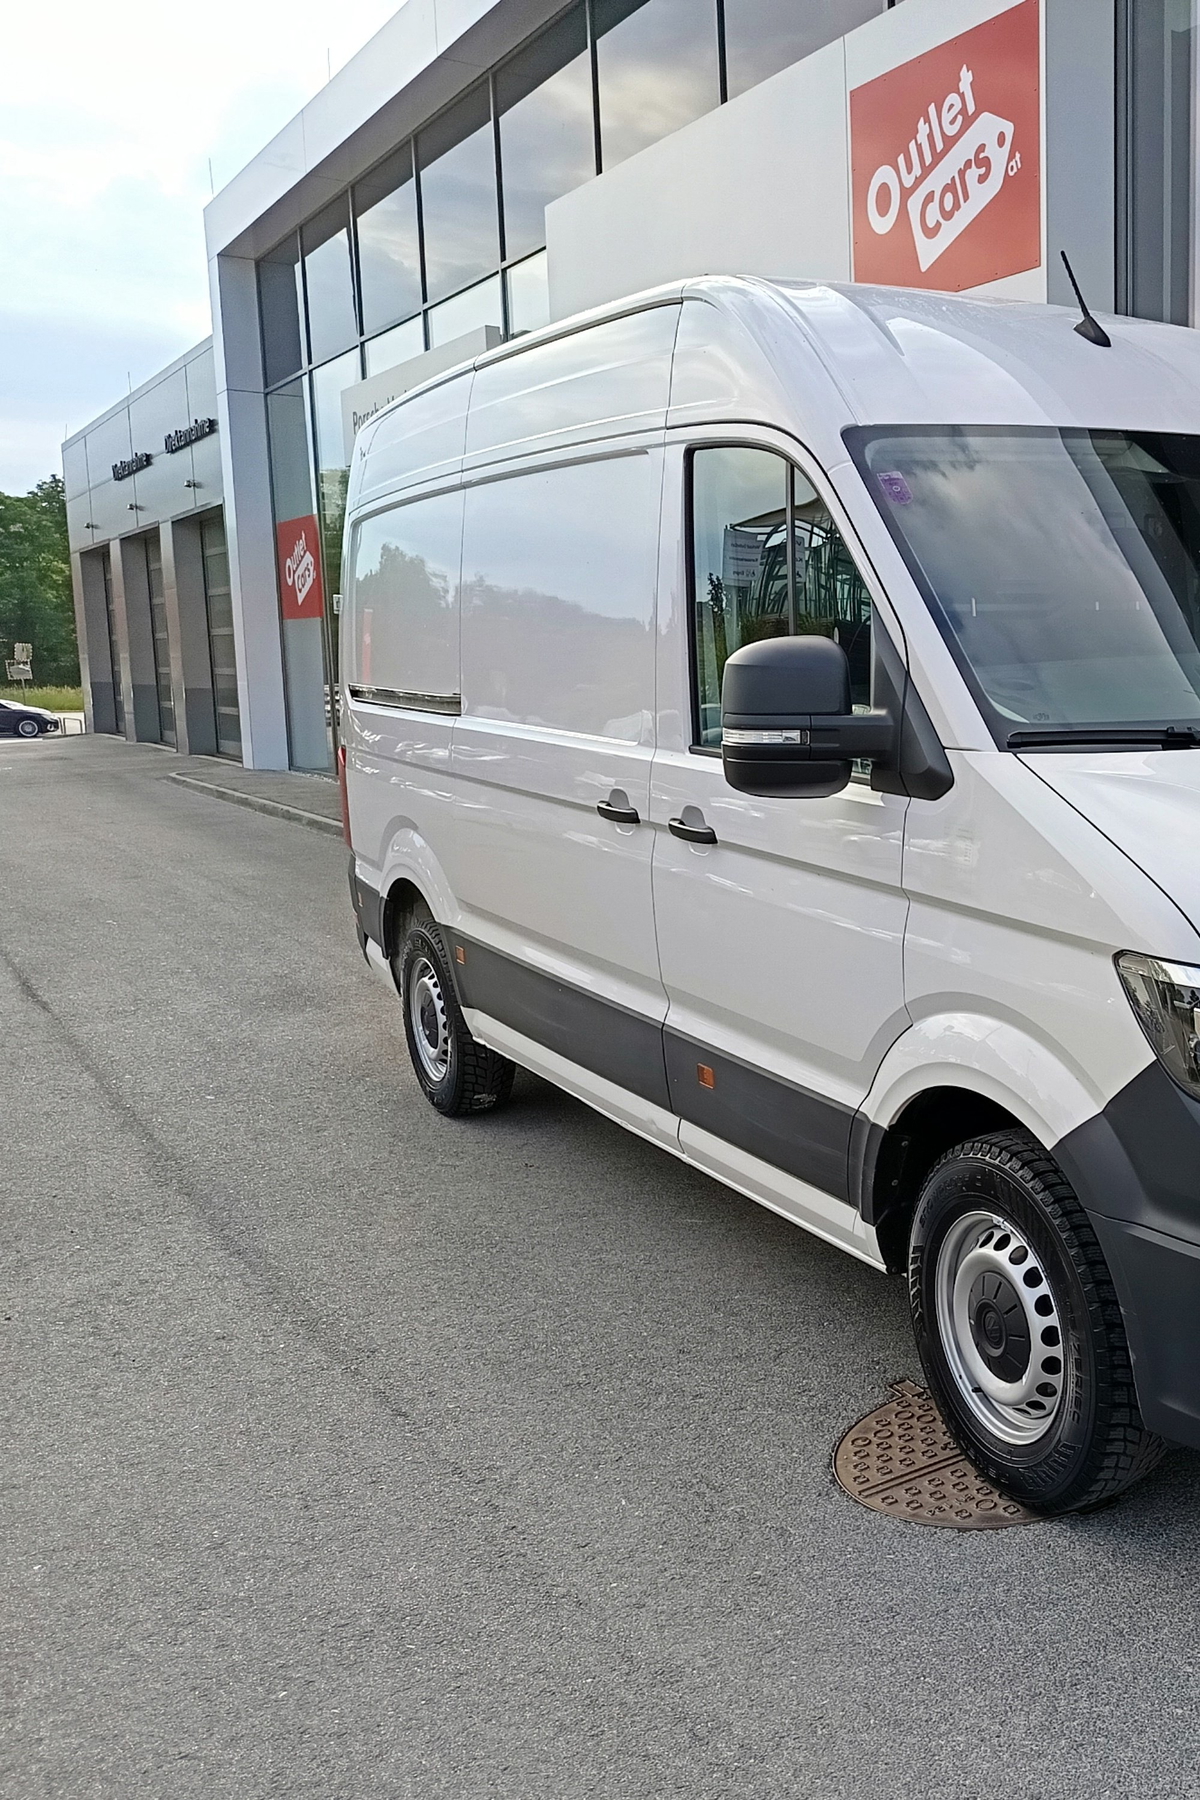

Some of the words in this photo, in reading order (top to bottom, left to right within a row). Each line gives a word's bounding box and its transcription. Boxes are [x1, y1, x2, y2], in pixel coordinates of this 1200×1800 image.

[867, 64, 976, 234] Outlet
[920, 143, 992, 240] Cars
[1008, 151, 1022, 176] at
[286, 530, 306, 586] Outlet
